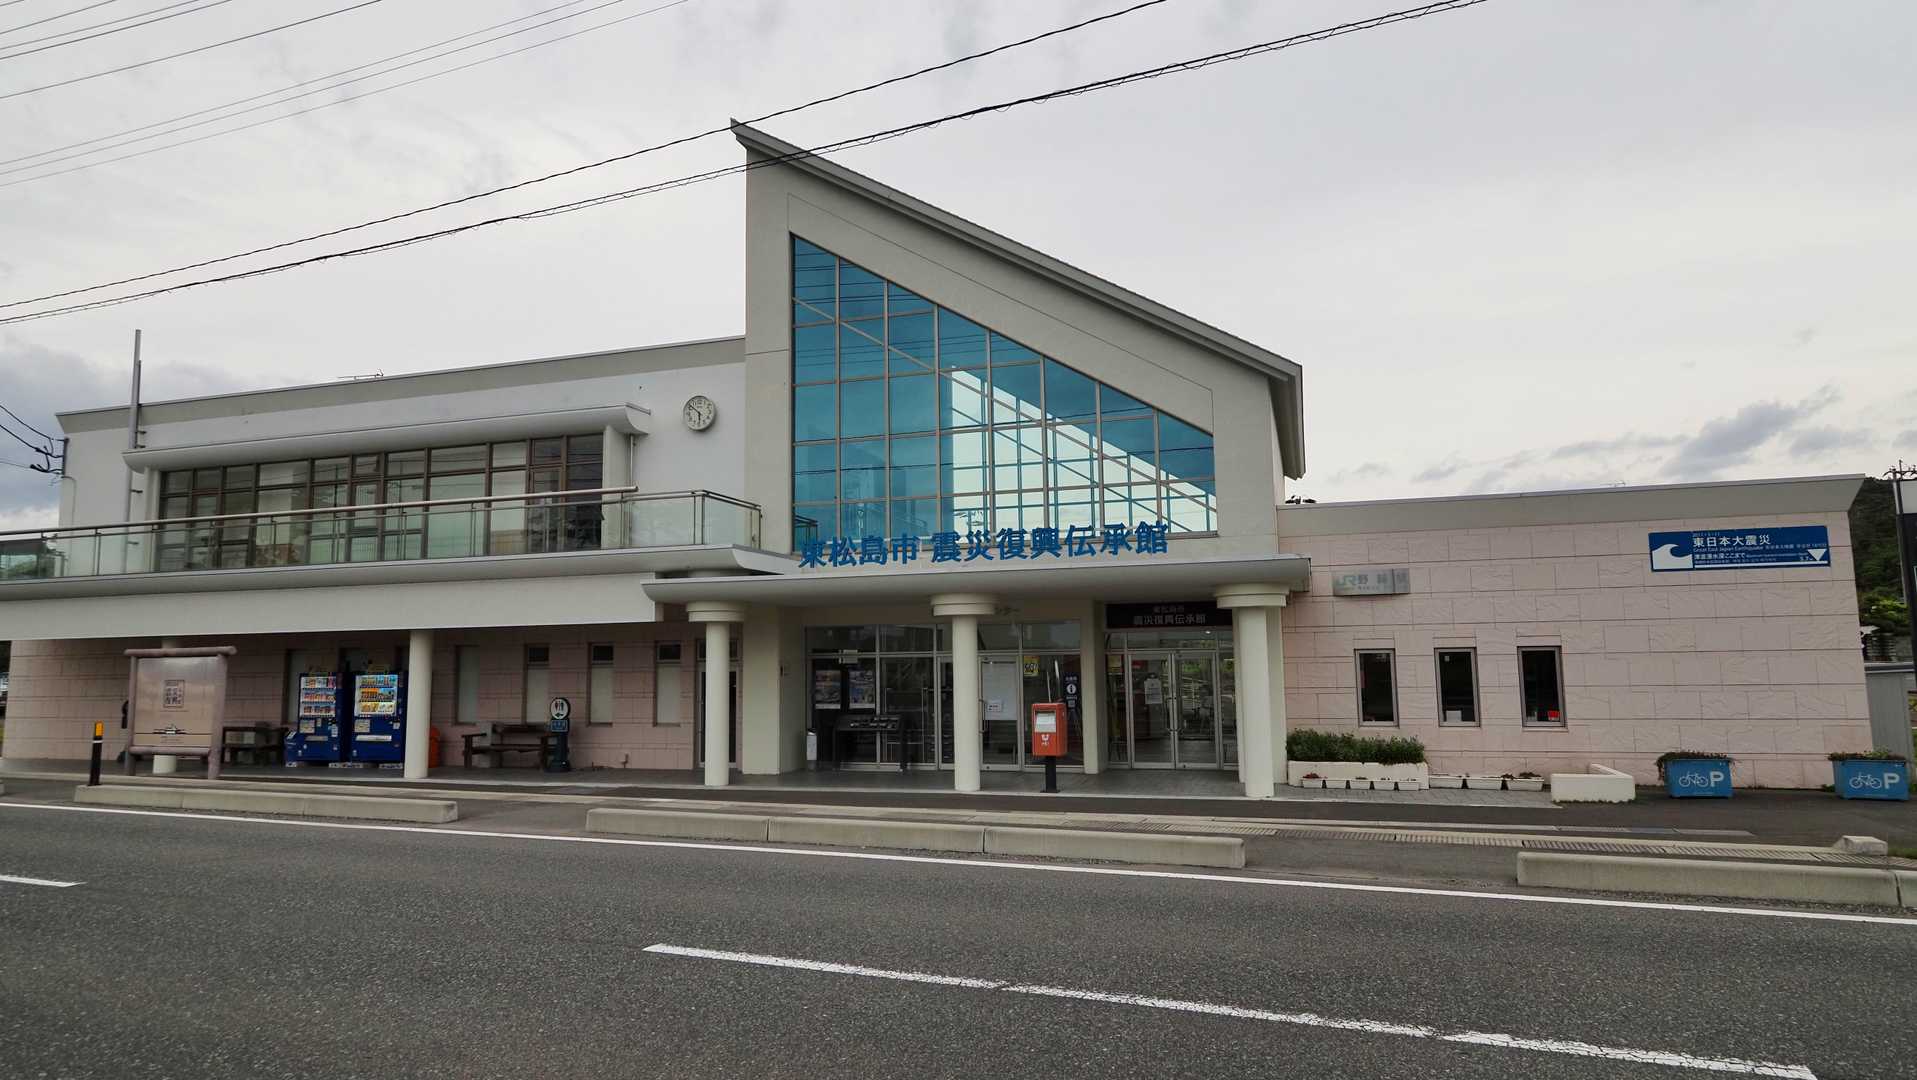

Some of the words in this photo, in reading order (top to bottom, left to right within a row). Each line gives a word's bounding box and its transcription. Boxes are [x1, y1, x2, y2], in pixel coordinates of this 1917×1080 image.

[799, 532, 918, 568] 東松島市
[930, 520, 1169, 563] 震災復興伝承館
[1693, 534, 1771, 547] 東日本大震災
[1709, 771, 1725, 787] P
[1883, 772, 1900, 789] P
